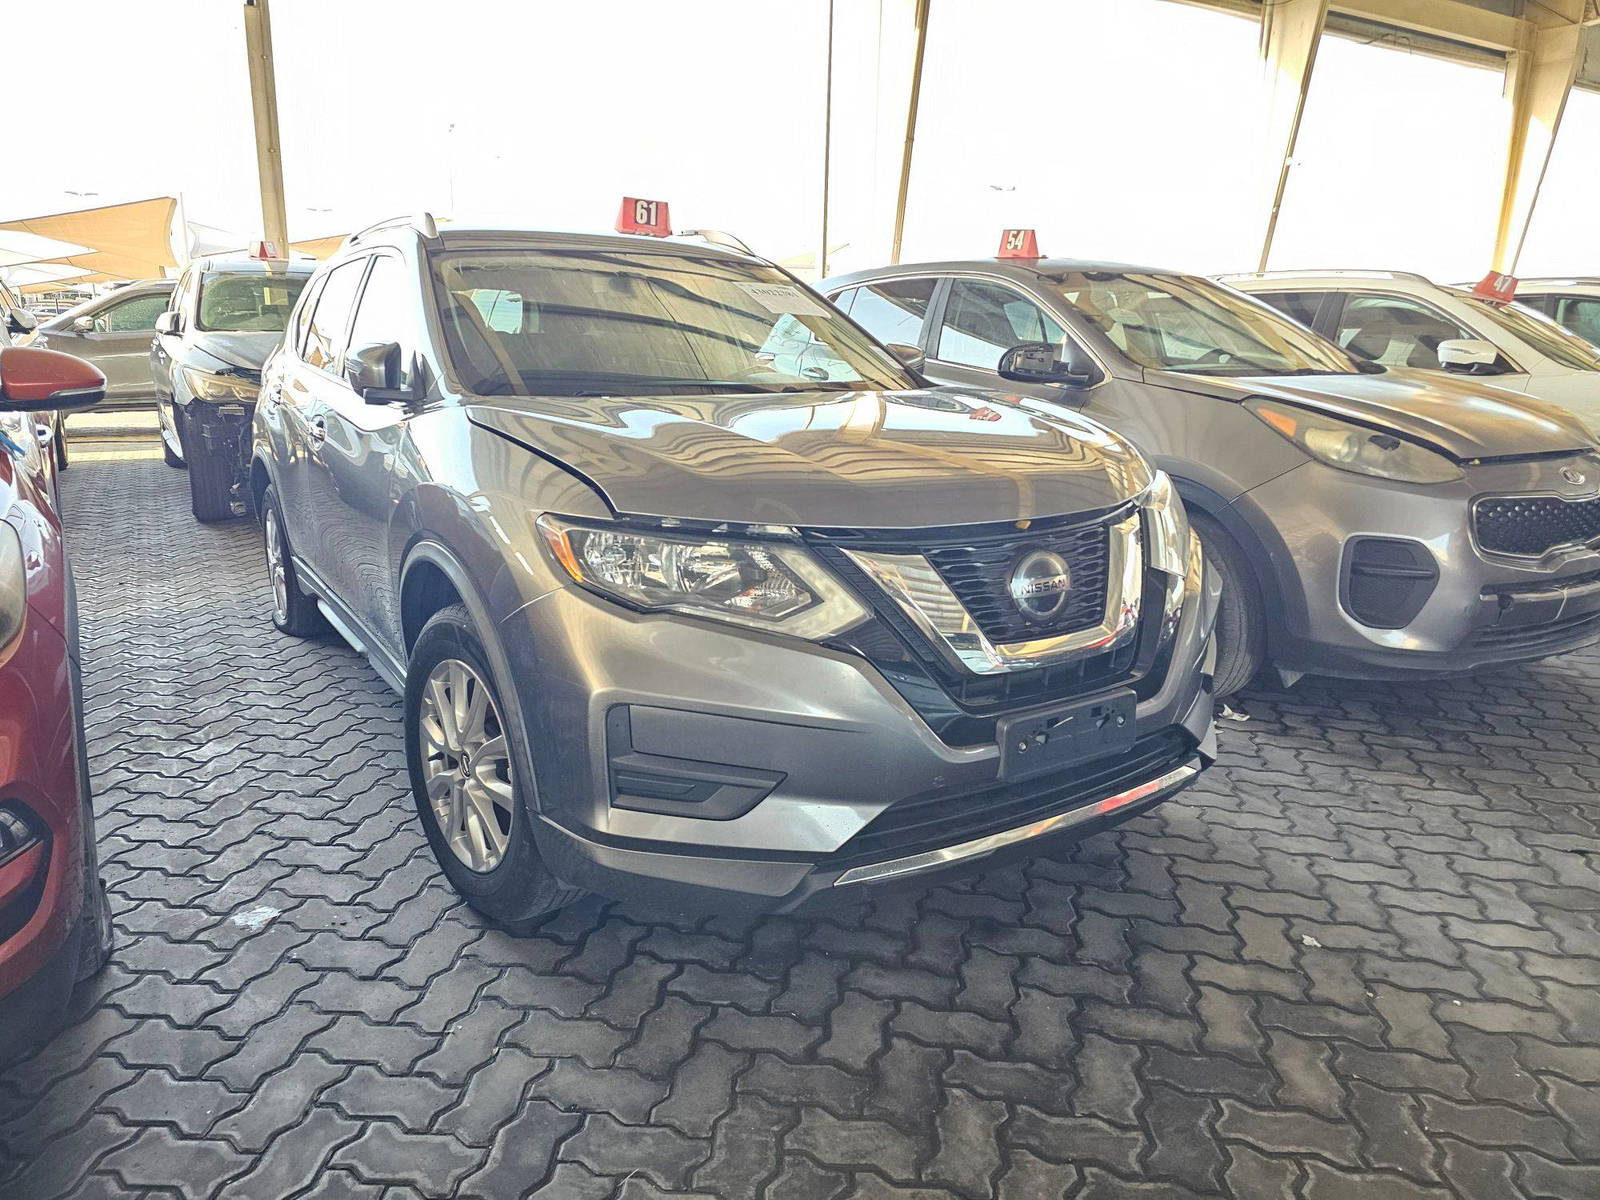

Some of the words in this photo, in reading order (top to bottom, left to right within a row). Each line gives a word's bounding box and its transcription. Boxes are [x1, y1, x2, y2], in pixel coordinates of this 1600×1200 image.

[636, 200, 657, 226] 61
[1007, 230, 1025, 250] 54
[1021, 579, 1066, 595] NISSAN
